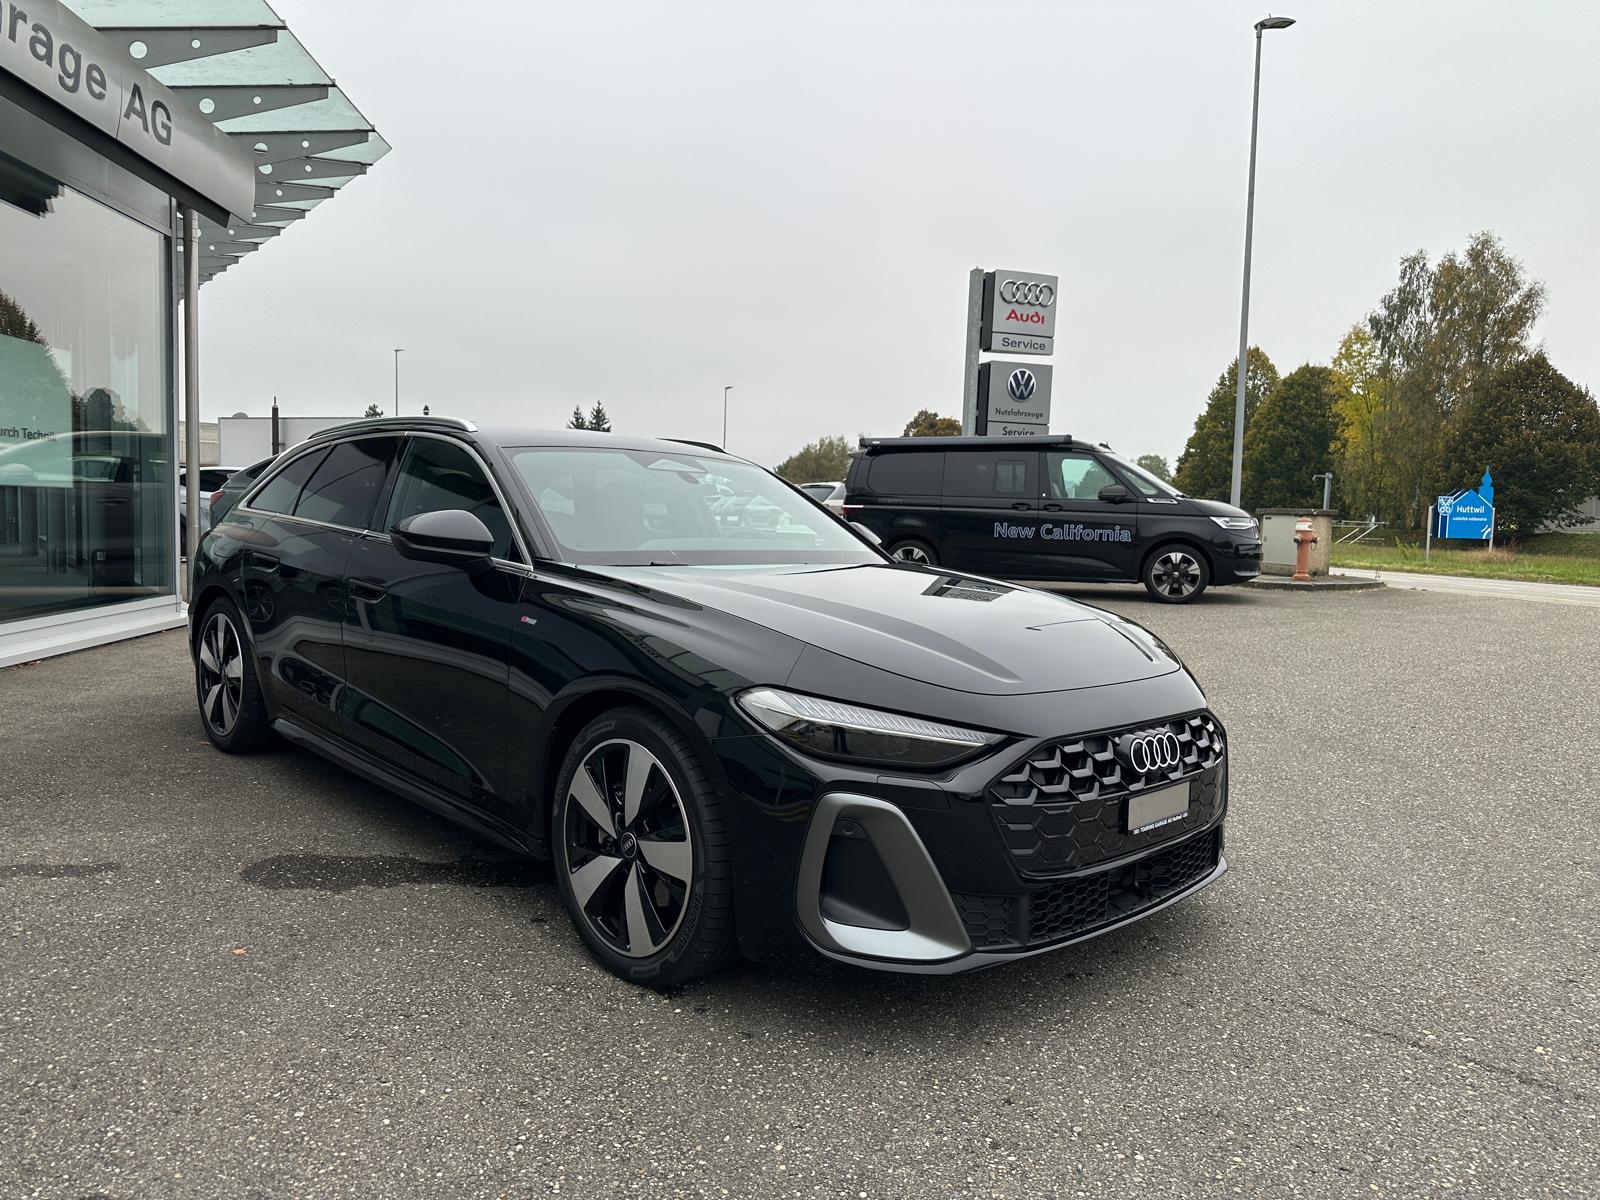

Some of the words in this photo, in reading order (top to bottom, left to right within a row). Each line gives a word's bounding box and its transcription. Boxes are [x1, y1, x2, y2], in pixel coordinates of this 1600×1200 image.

[0, 2, 107, 101] rage
[123, 82, 172, 147] AG
[1005, 309, 1045, 325] Audi
[1001, 337, 1046, 351] Service
[995, 407, 1044, 419] Nutzfahrzeuge
[1456, 505, 1485, 514] Huttwil
[994, 522, 1036, 539] New
[1040, 523, 1132, 542] California
